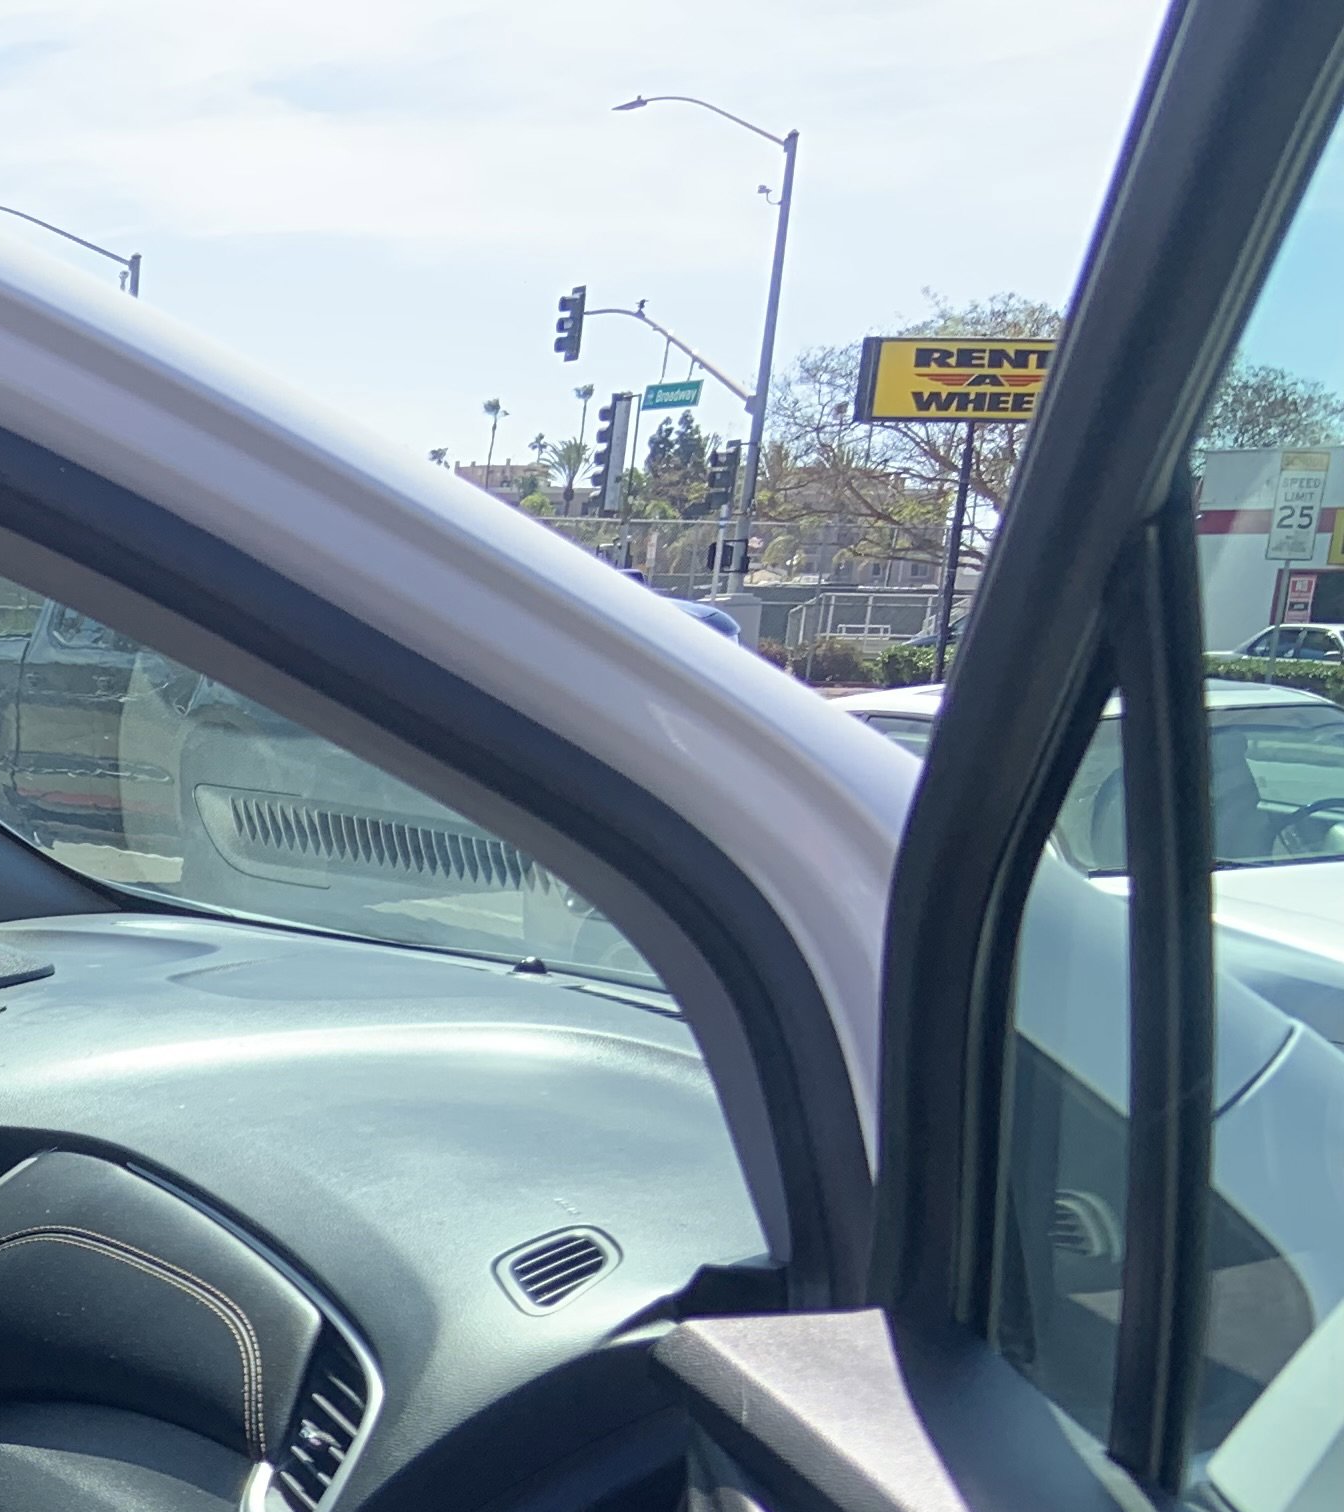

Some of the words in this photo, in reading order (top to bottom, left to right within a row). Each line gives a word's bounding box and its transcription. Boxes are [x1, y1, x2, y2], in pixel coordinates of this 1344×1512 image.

[914, 348, 1052, 369] RENT
[965, 374, 1006, 387] A
[655, 388, 697, 404] Broadway
[911, 391, 1037, 413] WHEE
[1282, 478, 1321, 489] SPEED
[1284, 491, 1315, 502] LIMIT
[1276, 505, 1314, 530] 25
